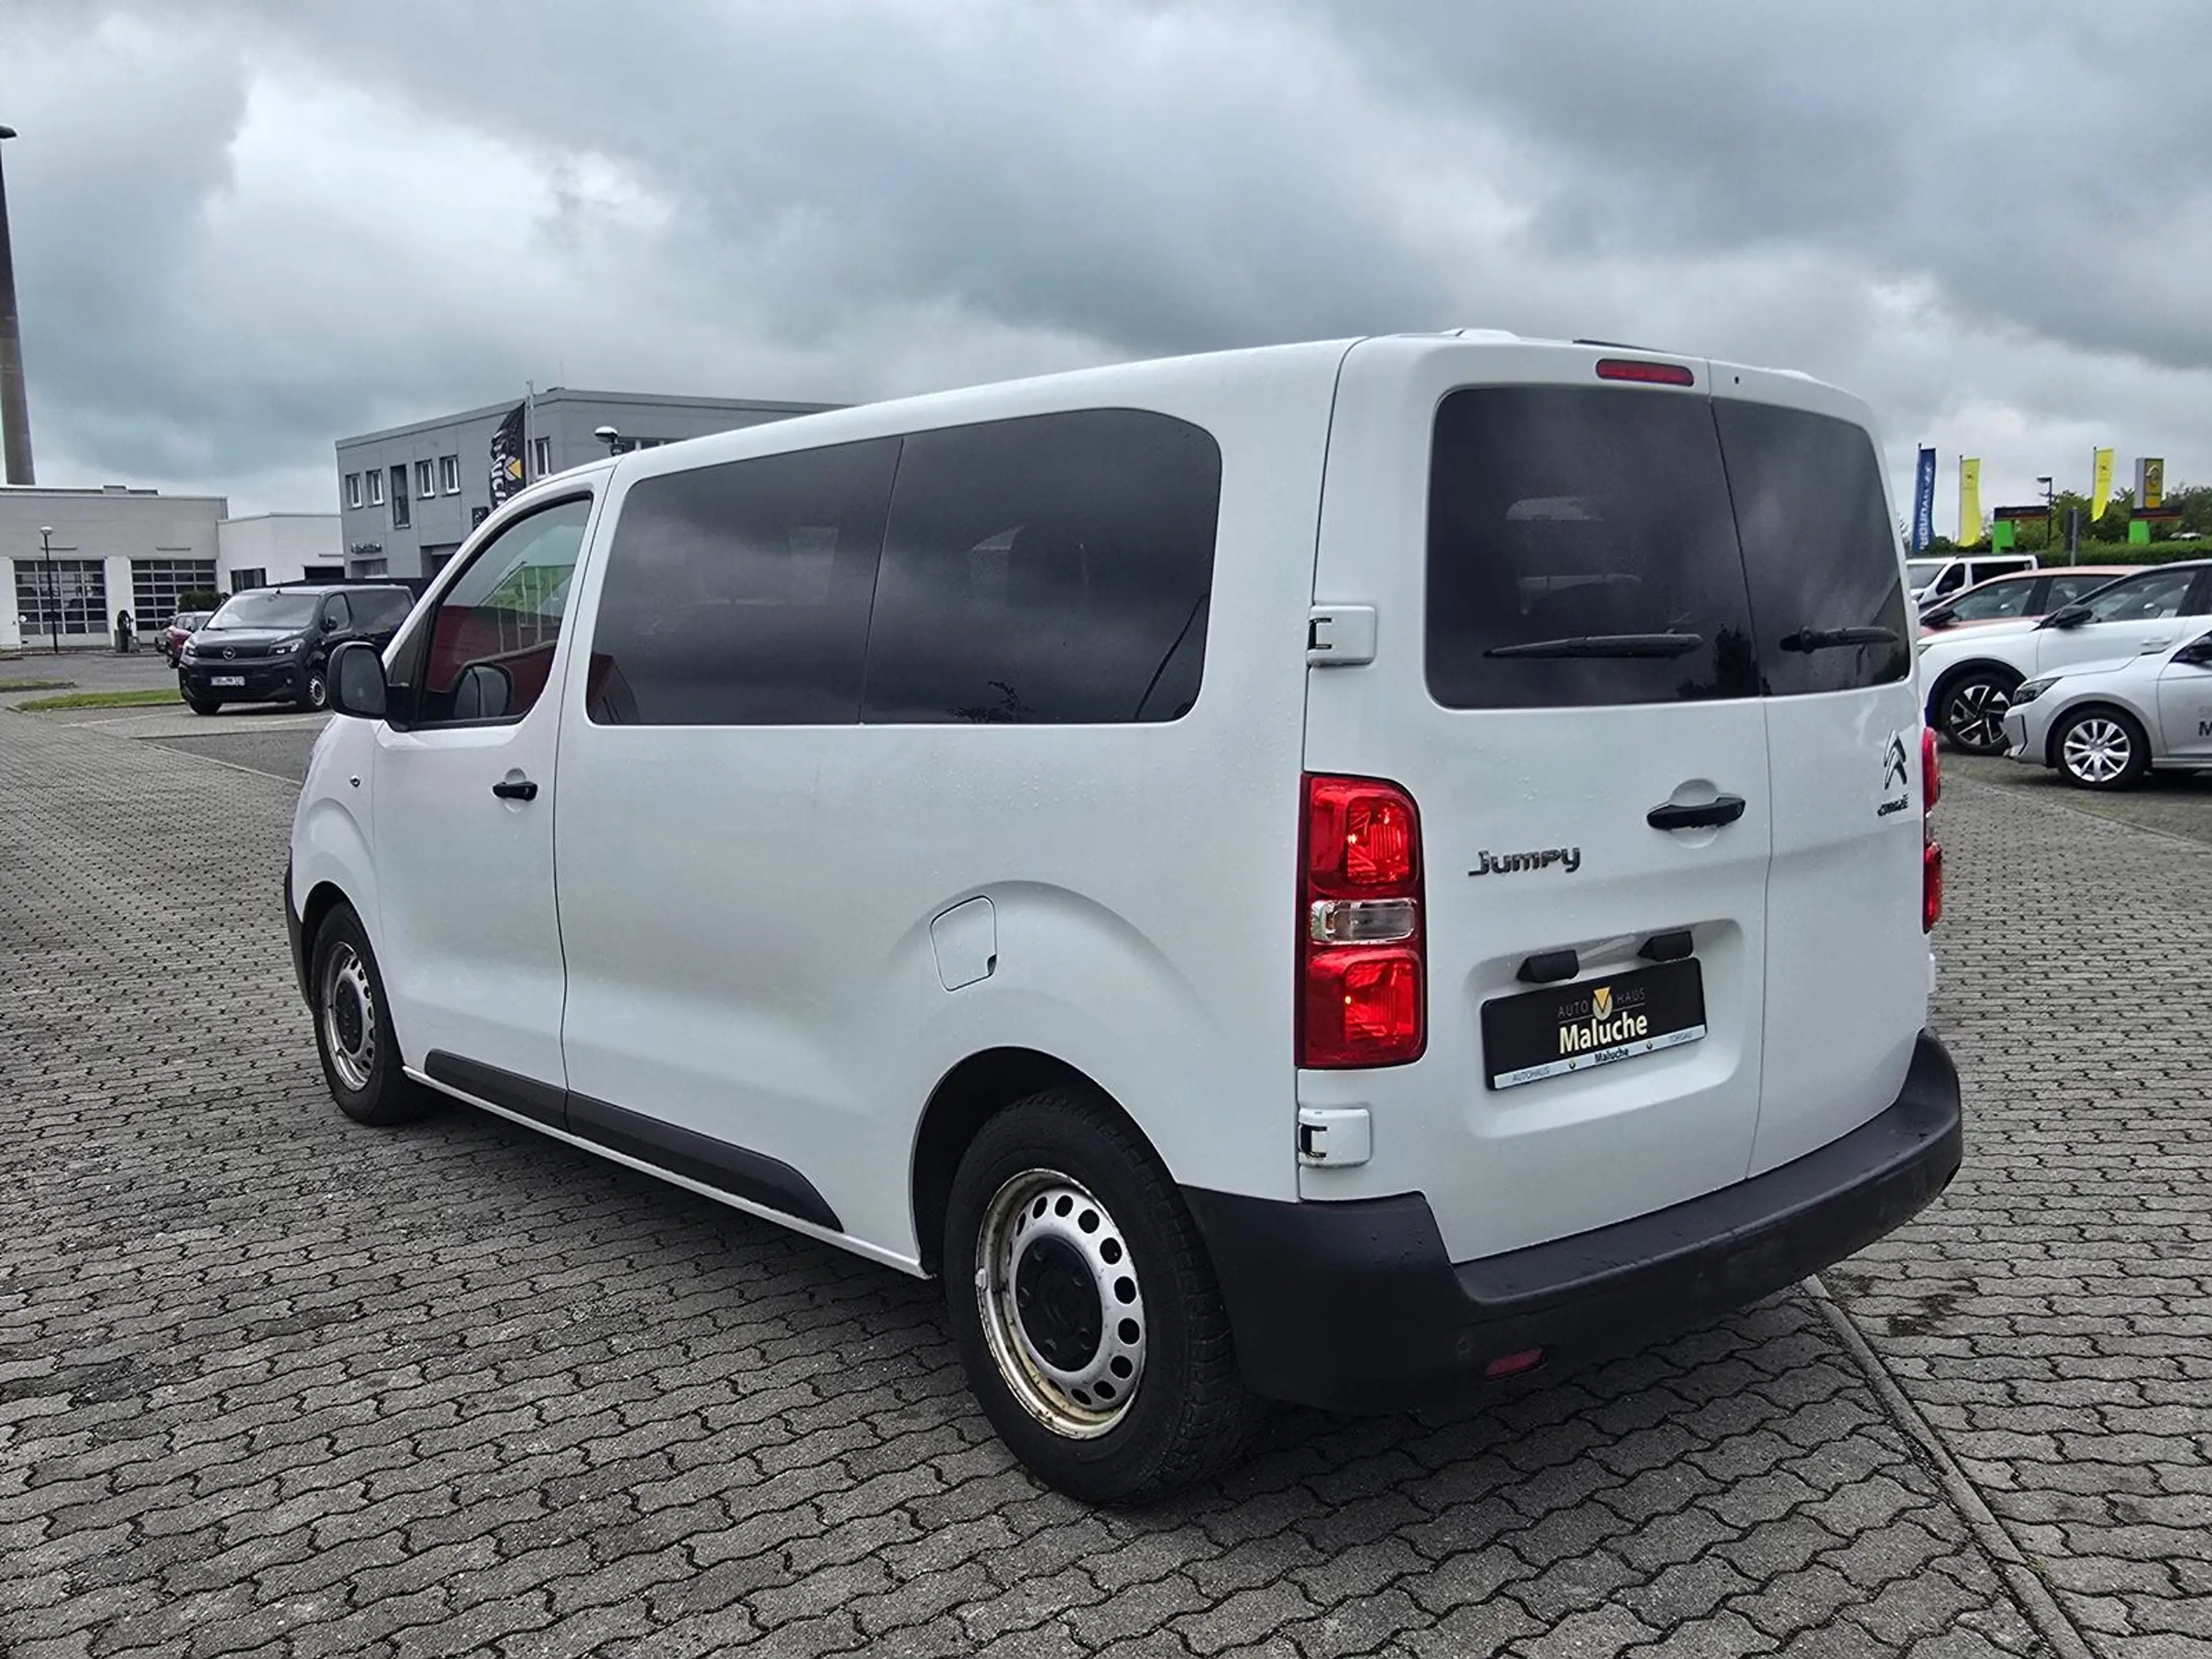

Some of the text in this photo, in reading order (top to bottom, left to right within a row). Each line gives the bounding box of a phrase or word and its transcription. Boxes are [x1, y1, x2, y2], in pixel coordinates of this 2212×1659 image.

[1468, 847, 1580, 876] Jumpy
[1558, 987, 1646, 1018] AUTO HAUS
[1559, 1012, 1648, 1054] Maluche
[1594, 1047, 1629, 1062] Maluche
